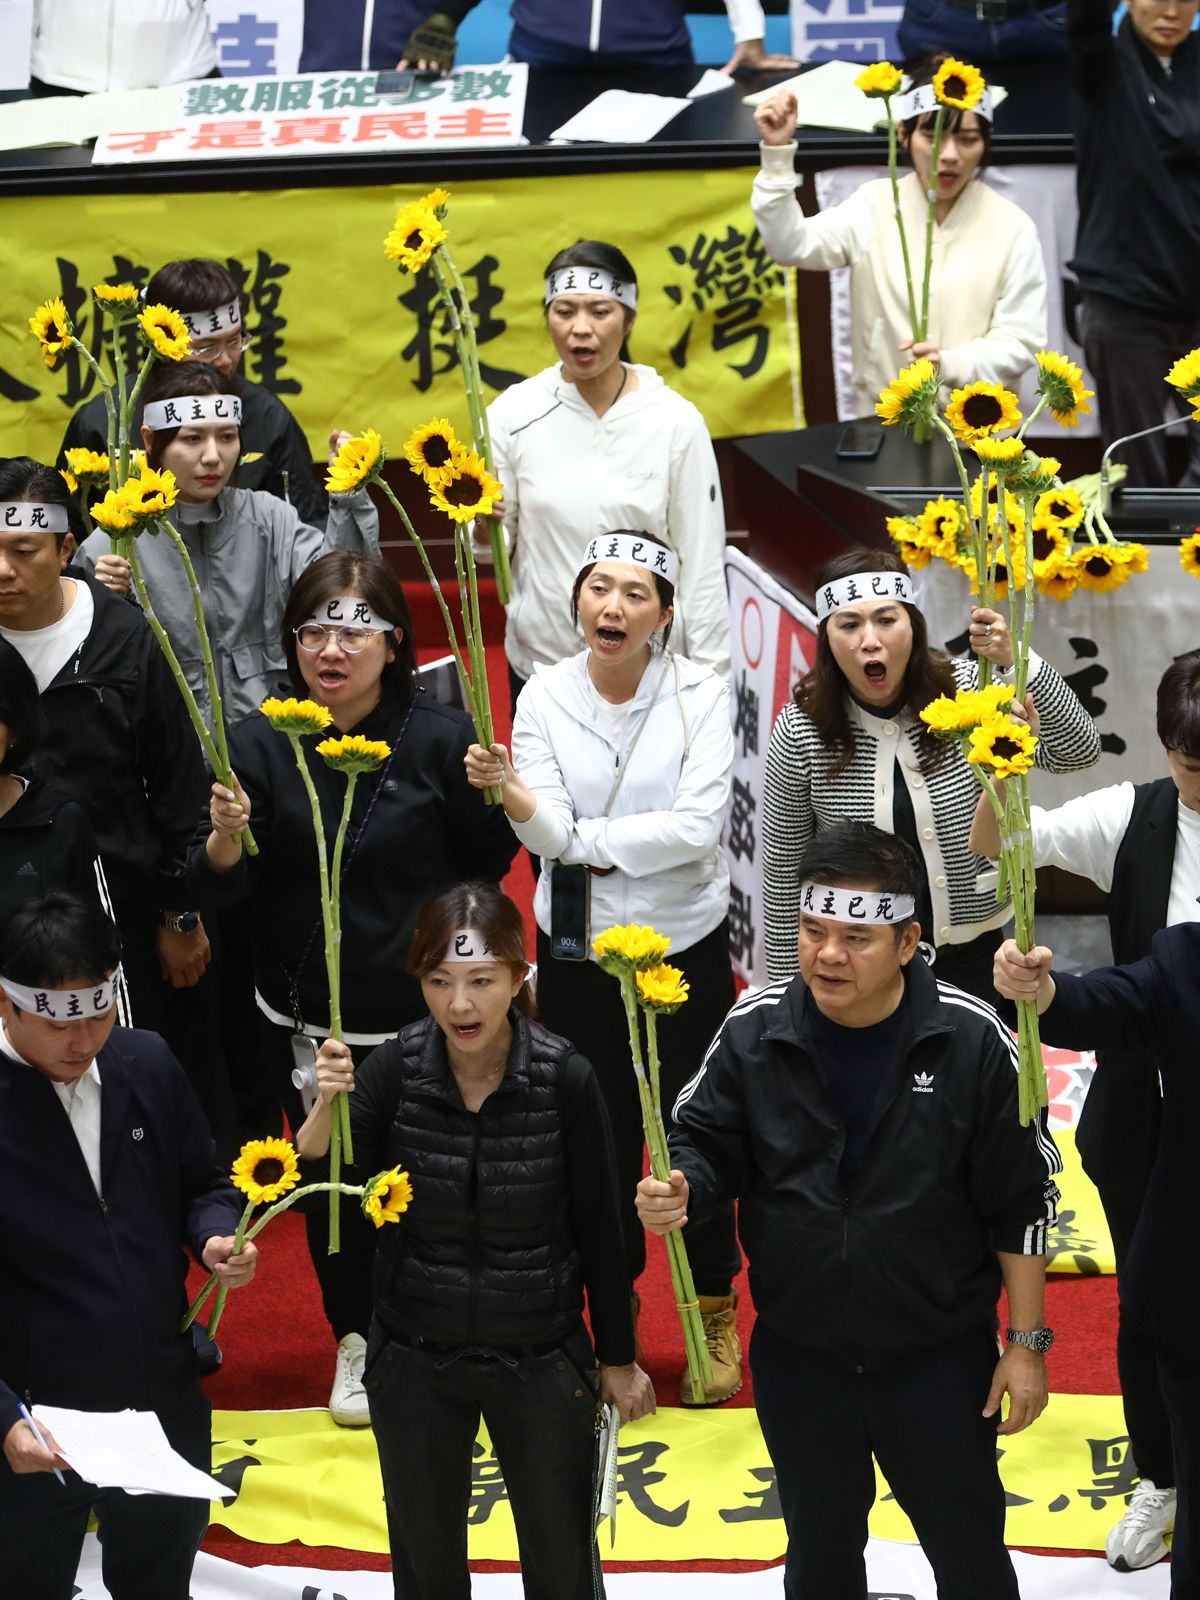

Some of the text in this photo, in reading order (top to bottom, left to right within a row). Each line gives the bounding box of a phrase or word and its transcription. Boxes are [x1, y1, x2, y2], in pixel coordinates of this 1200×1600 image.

[106, 108, 512, 155] 才是真民主
[163, 399, 242, 424] 民主已死
[5, 506, 49, 529] 已死
[586, 537, 668, 574] 民主已死
[823, 576, 908, 610] 民主已死
[309, 600, 372, 624] 已死
[803, 884, 895, 920] 民主已死
